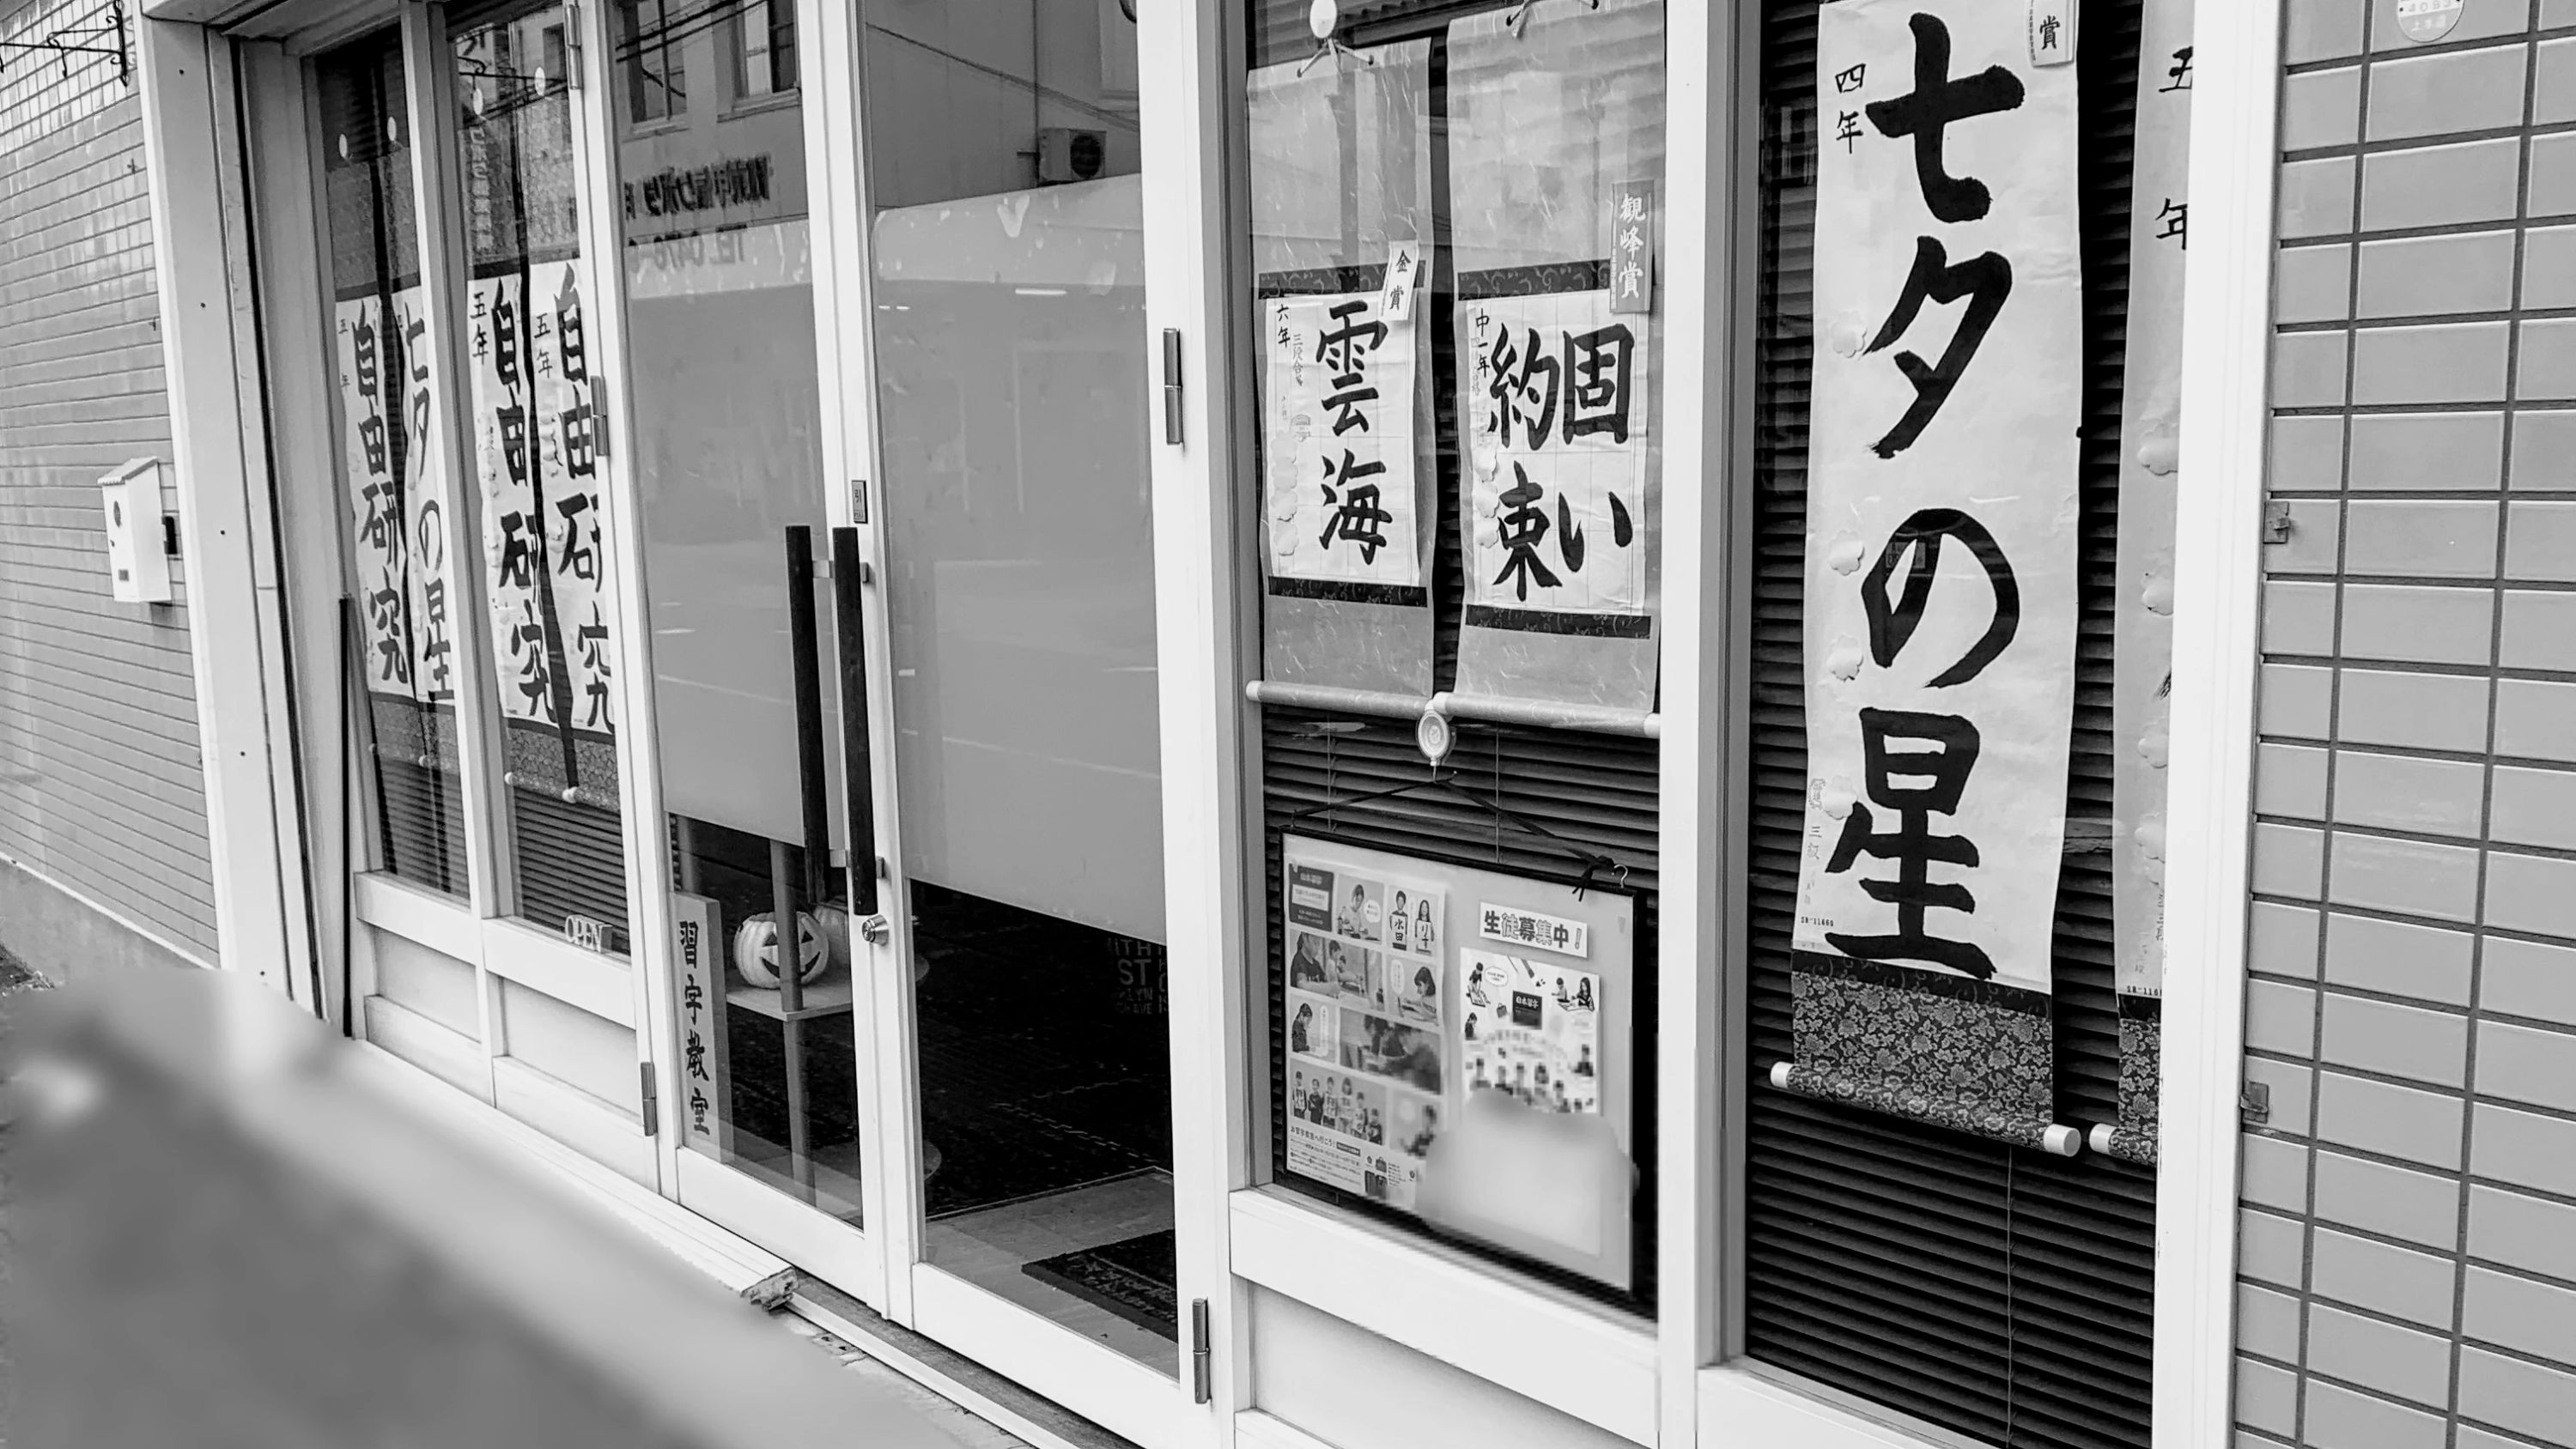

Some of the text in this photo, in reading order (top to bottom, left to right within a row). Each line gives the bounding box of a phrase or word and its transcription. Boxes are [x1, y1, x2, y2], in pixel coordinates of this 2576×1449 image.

[2039, 15, 2061, 50] 賞
[1835, 63, 1867, 154] 四年
[1389, 249, 1412, 312] 金賞
[1619, 192, 1646, 300] 観峰賞
[471, 291, 489, 365] 五年
[534, 312, 553, 379] 五年
[1277, 304, 1291, 349] 六年
[1475, 307, 1491, 379] 中一年
[1315, 300, 1394, 566] 雲海
[351, 300, 409, 684] 自由研究
[491, 278, 557, 723] 自由研究
[1825, 12, 2026, 980] 七夕の星
[565, 915, 604, 953] OPEN
[1117, 958, 1152, 986] ST
